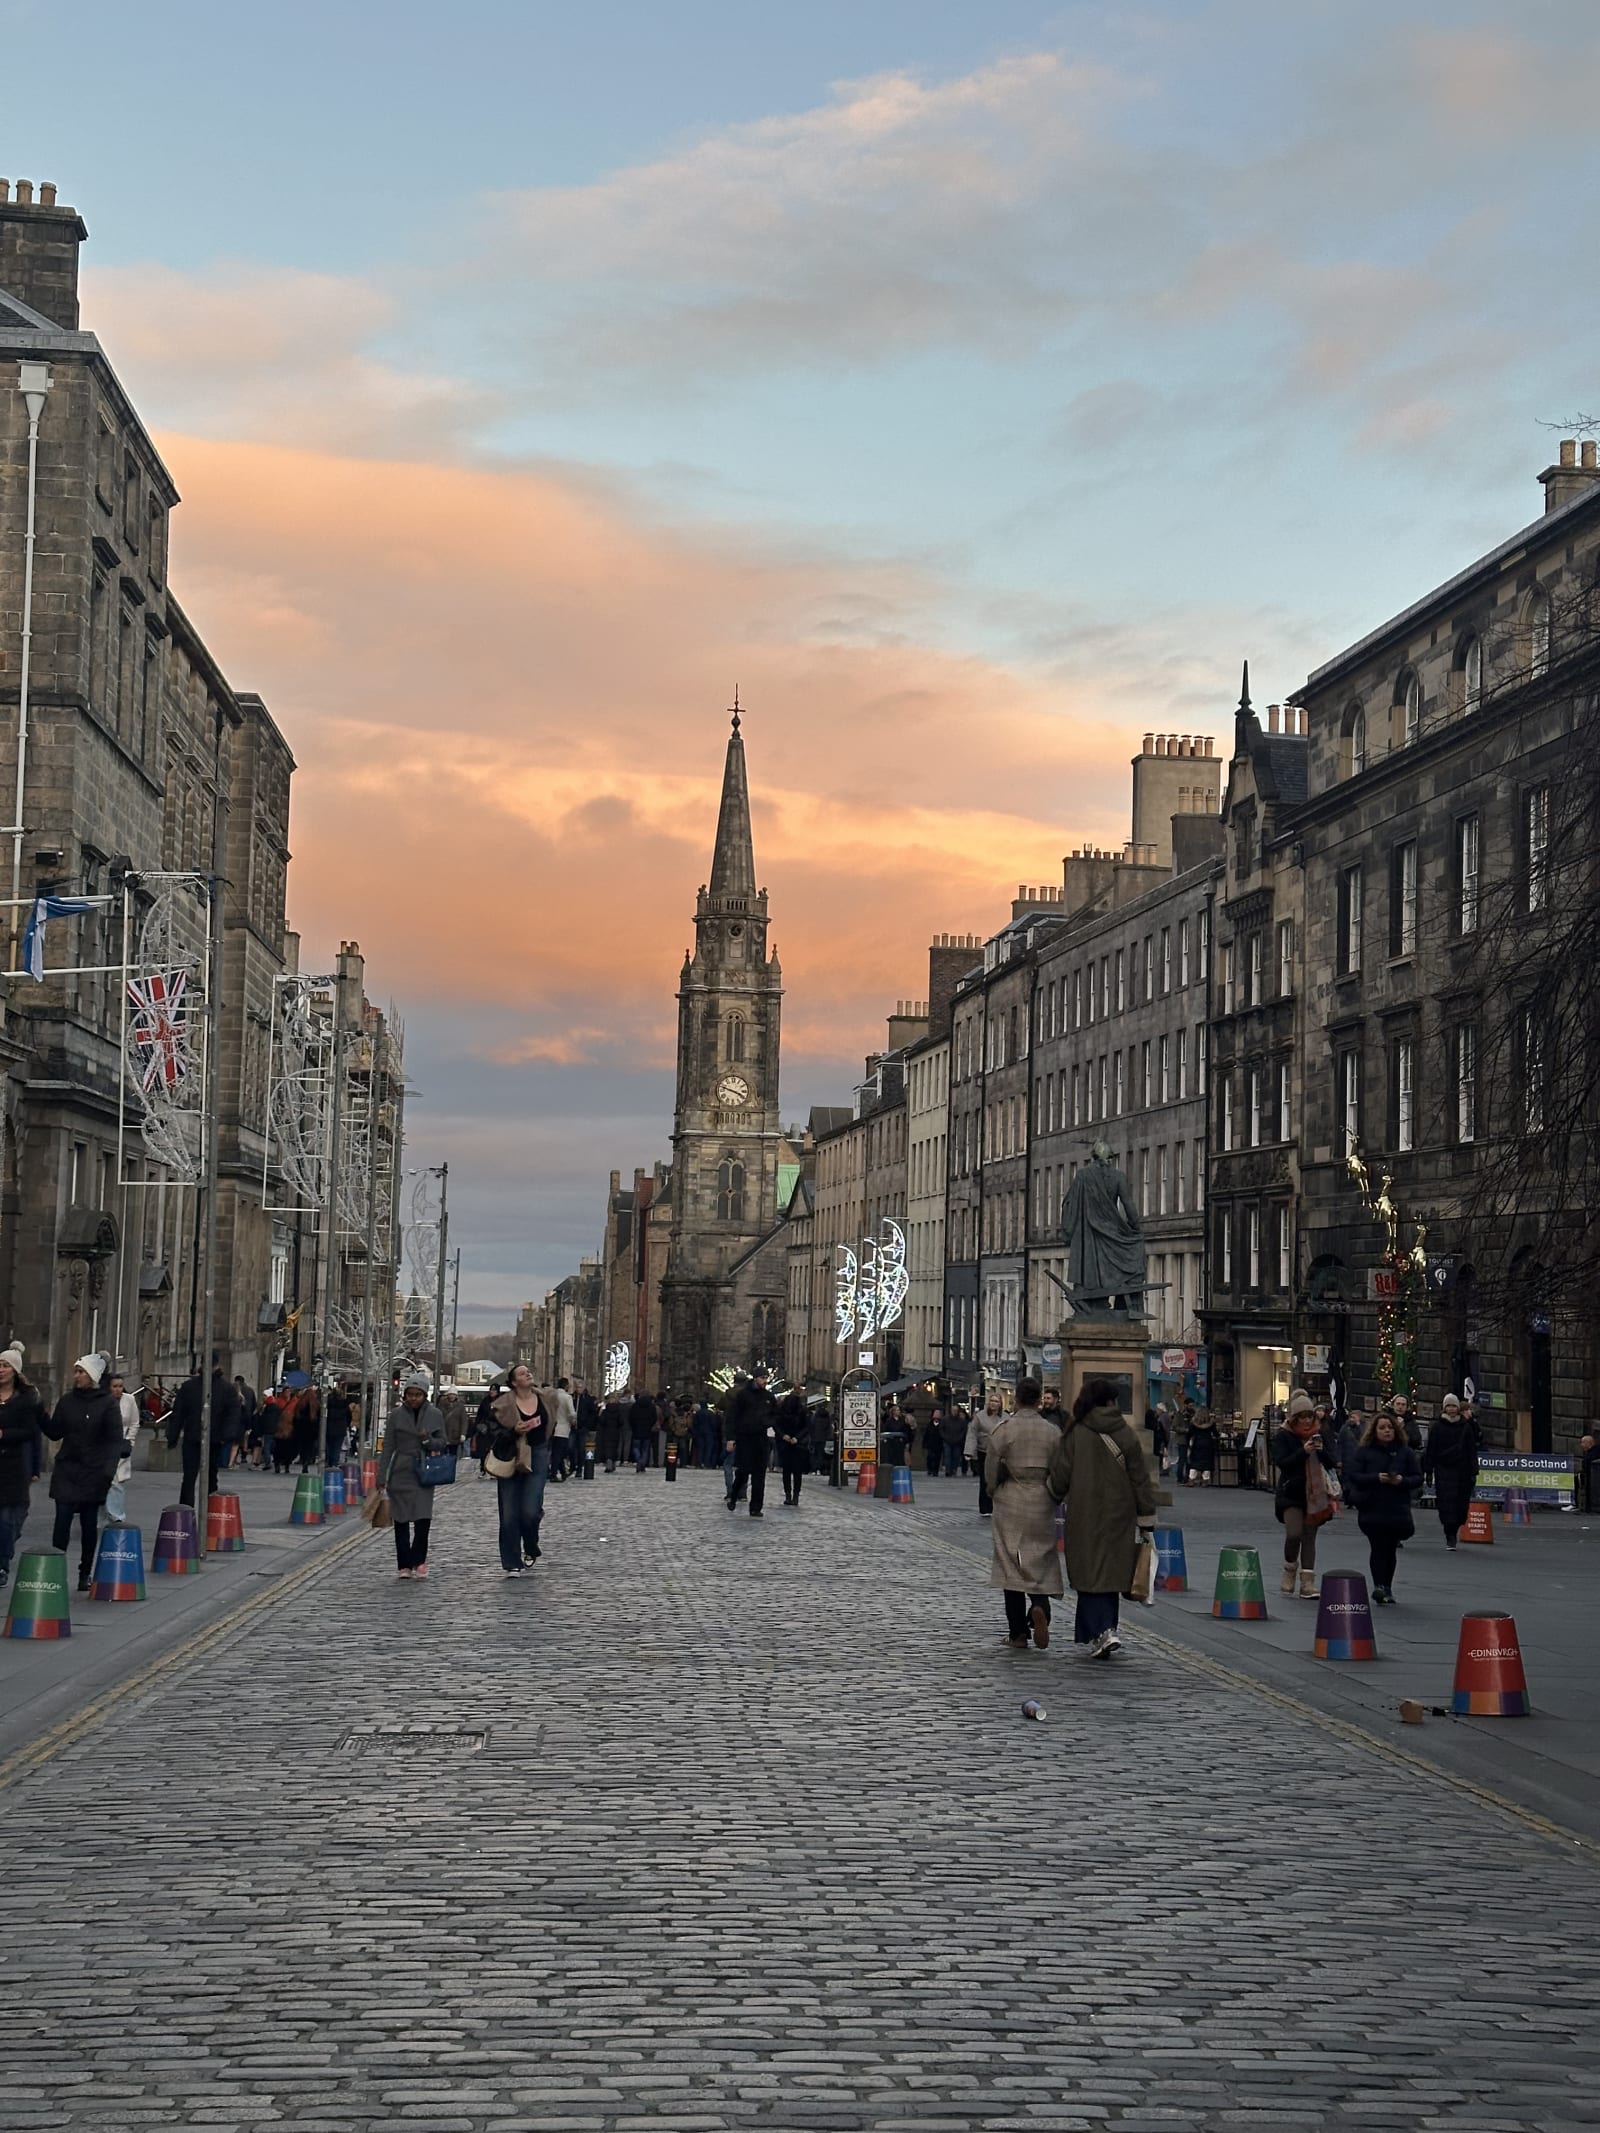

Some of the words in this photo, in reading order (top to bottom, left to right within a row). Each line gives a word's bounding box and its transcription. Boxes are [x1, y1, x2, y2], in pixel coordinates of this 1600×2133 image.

[1477, 1457, 1505, 1467] Tours
[1508, 1458, 1518, 1467] of
[1520, 1459, 1567, 1469] Scotland
[1483, 1473, 1520, 1484] BOOK
[1525, 1475, 1559, 1486] HERE
